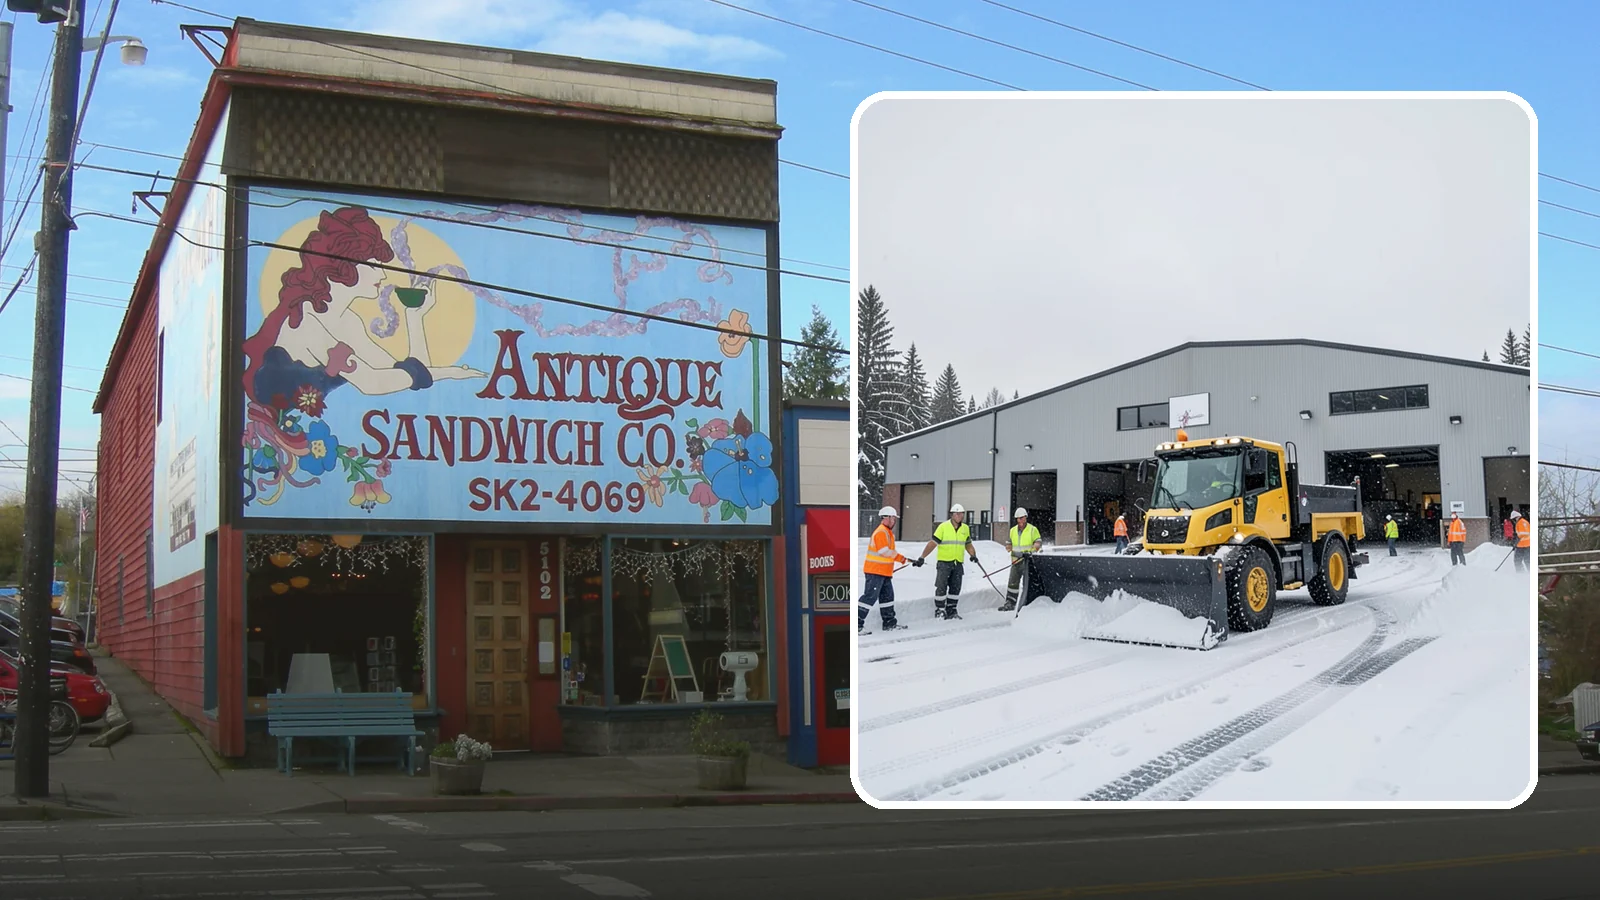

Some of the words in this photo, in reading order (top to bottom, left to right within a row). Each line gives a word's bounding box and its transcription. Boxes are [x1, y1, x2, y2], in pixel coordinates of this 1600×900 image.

[476, 329, 724, 421] ANTIQUE
[361, 408, 605, 468] SANDWICH
[616, 421, 686, 469] CO.
[468, 477, 646, 514] SK2-4069
[539, 541, 552, 600] 5102
[809, 555, 835, 569] BOOKS
